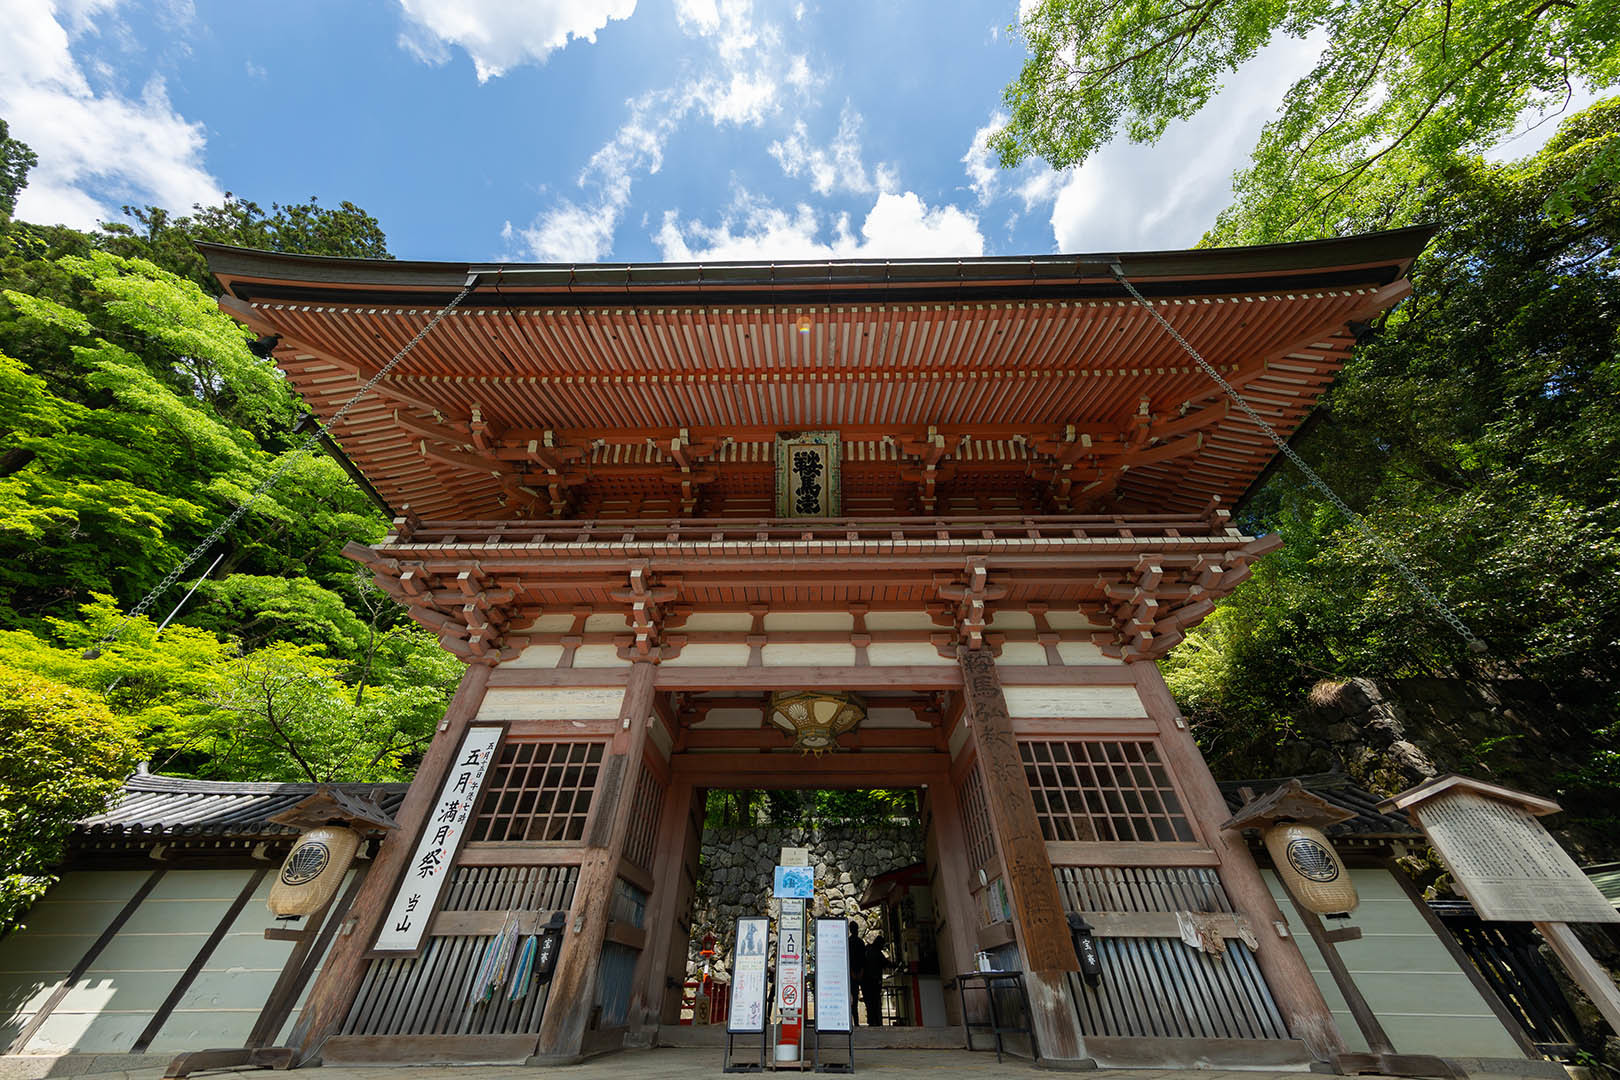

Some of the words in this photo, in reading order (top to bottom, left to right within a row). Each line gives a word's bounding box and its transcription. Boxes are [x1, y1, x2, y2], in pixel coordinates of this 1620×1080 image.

[417, 748, 481, 879] 五月満月祭
[396, 894, 421, 932] 当山
[787, 933, 795, 953] 入口
